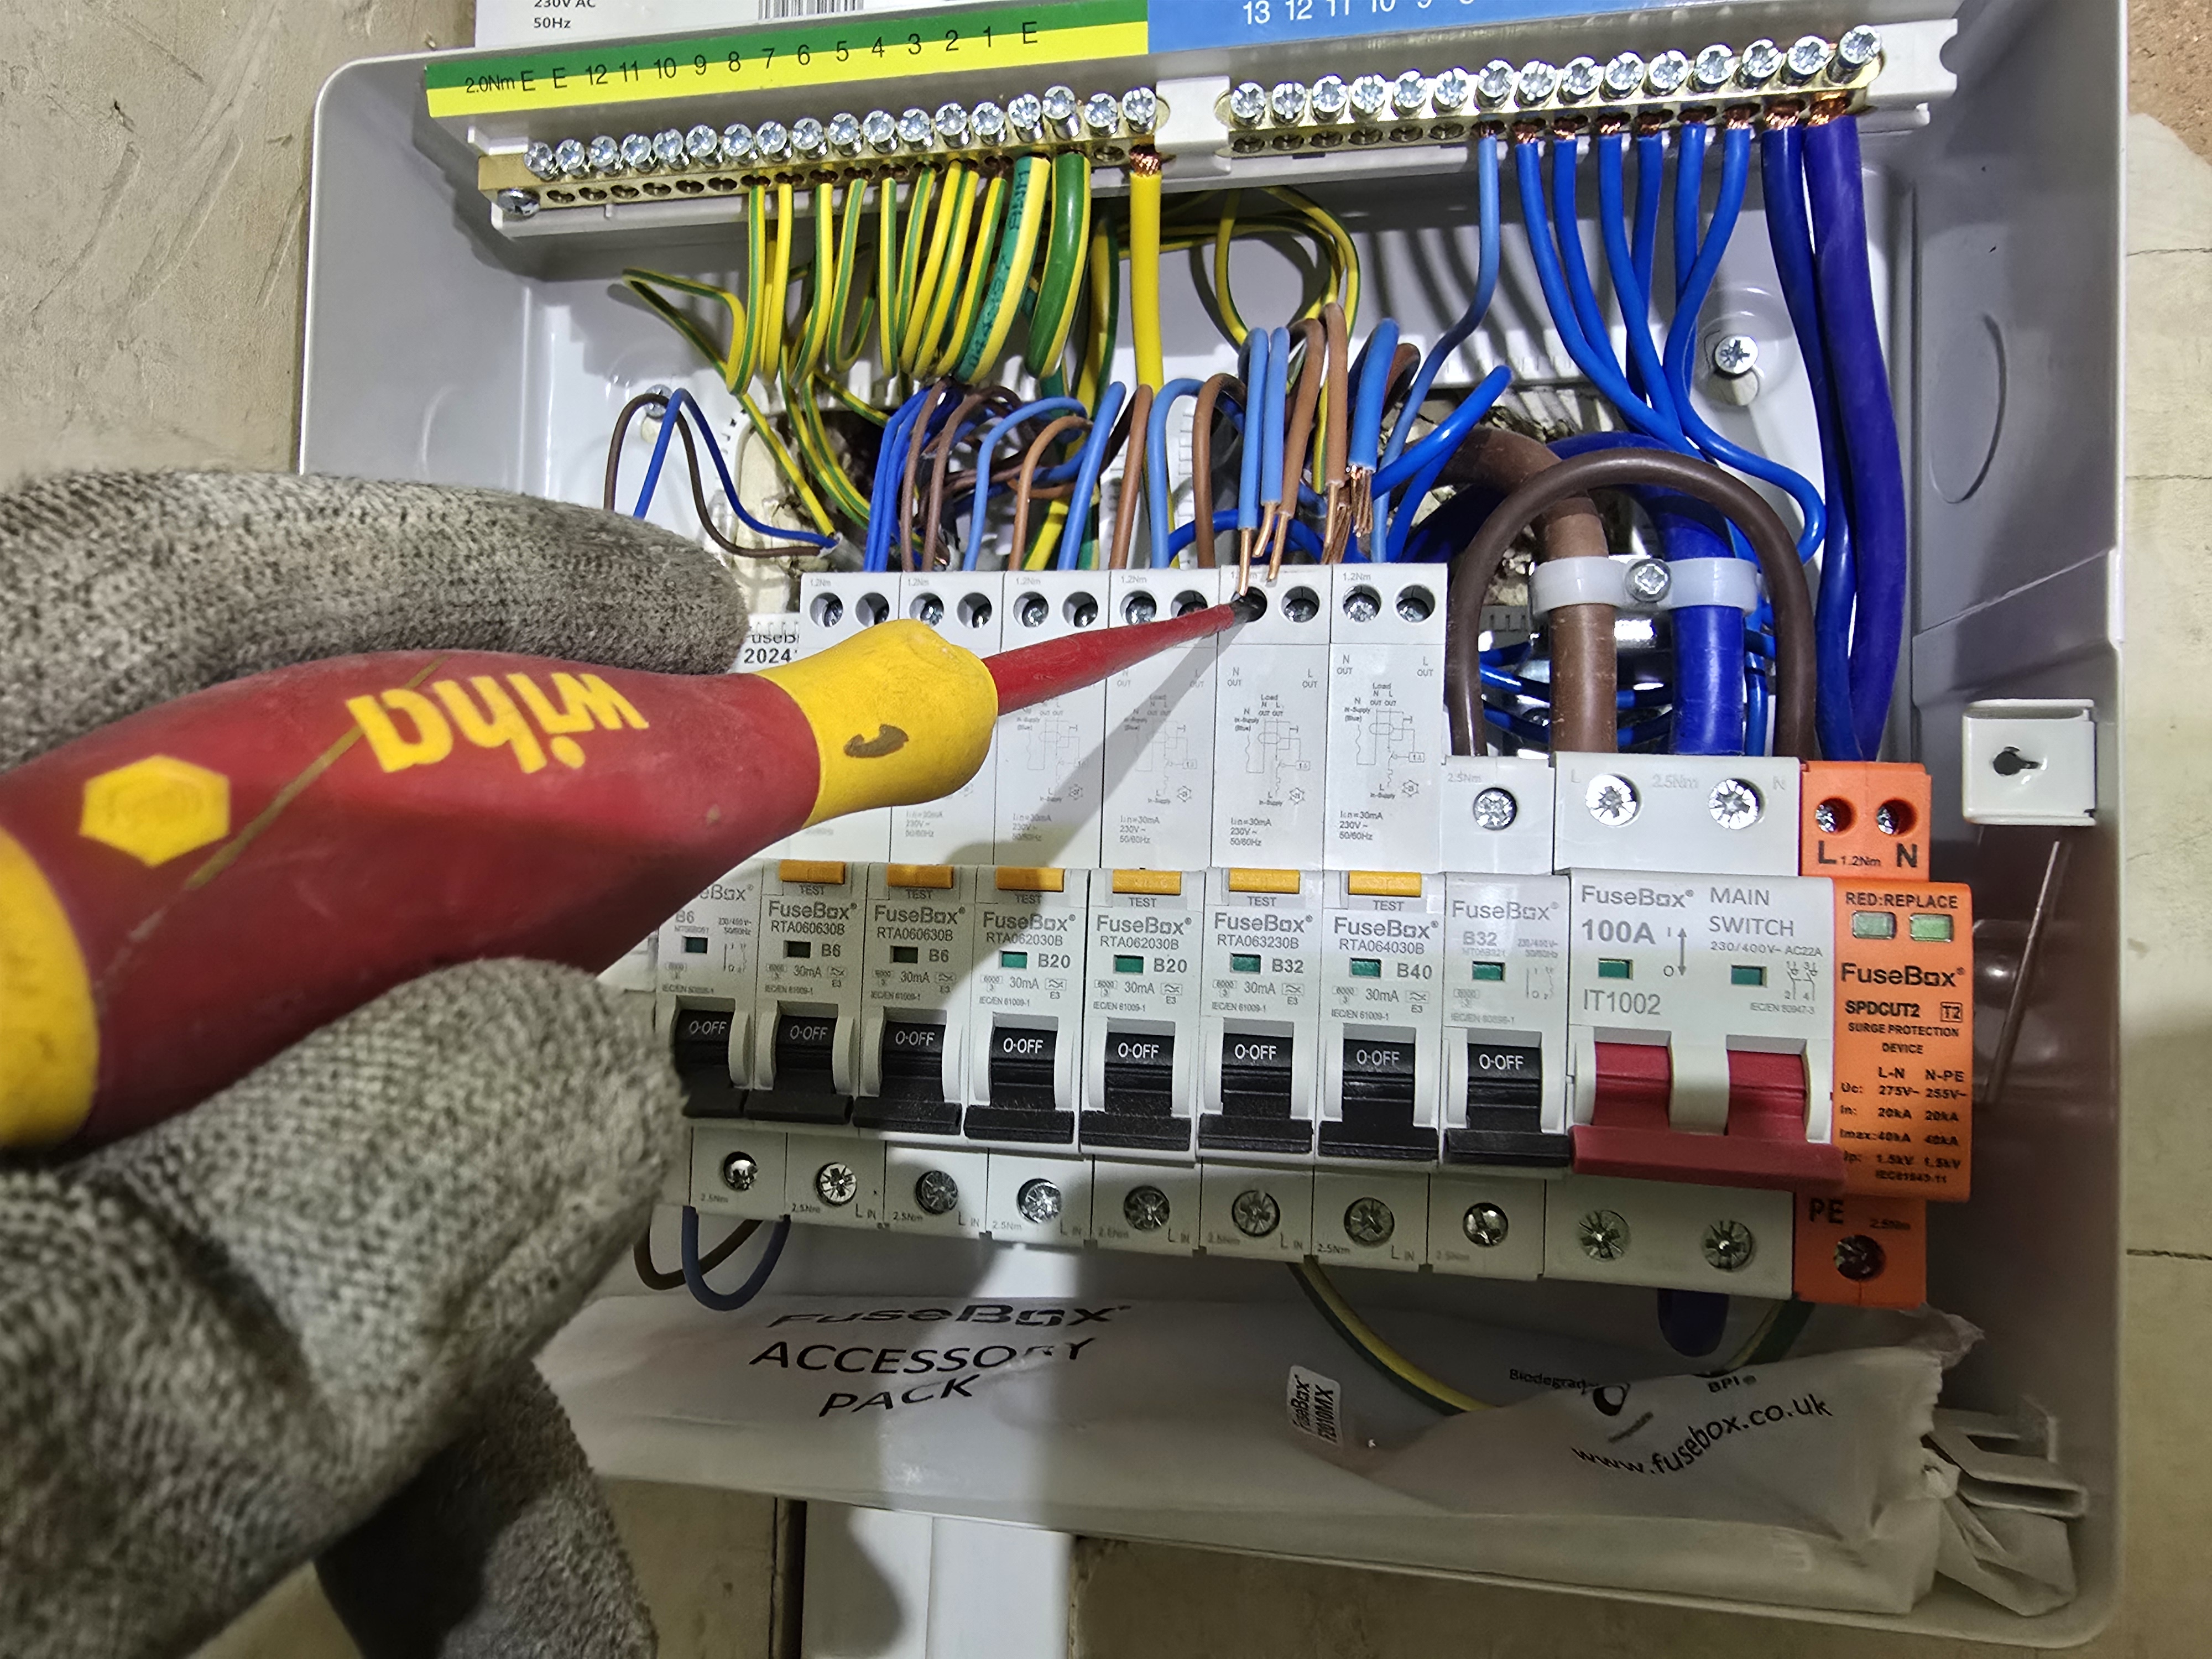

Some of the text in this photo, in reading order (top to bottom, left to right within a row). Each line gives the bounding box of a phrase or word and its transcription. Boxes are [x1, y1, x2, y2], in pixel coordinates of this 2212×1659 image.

[1243, 0, 1271, 25] 13
[1286, 0, 1313, 21] 12
[534, 17, 572, 29] 50Hz
[466, 21, 1039, 94] 2.0Nm E E 12 11 10 9 8 7 6 5 4 3 2 1 E
[1120, 575, 1147, 585] 1.2Nm
[1343, 572, 1371, 582] 1.2Nm
[1343, 654, 1350, 664] N
[1336, 666, 1353, 675] OUT
[1416, 668, 1434, 677] OUT
[1227, 679, 1242, 687] OUT
[1302, 681, 1318, 689] OUT
[1818, 839, 1837, 864] L
[1896, 842, 1918, 868] N
[800, 884, 824, 896] TEST
[905, 888, 933, 900] TEST
[1710, 886, 1770, 906] MAIN
[1014, 894, 1043, 905] TEST
[1129, 896, 1157, 908] TEST
[1247, 895, 1277, 907] TEST
[1373, 899, 1406, 912] TEST
[1845, 891, 1959, 909] RED:REPLACE
[1582, 919, 1656, 945] 100A
[1709, 915, 1794, 937] SWITCH
[986, 931, 1063, 947] RTA062030B
[1100, 935, 1180, 951] RTA062030B
[1217, 933, 1300, 950] RTA063230B
[1339, 937, 1425, 955] RTA064030B
[1462, 930, 1498, 947] B32
[929, 948, 950, 963] B6
[1785, 945, 1824, 957] AC22A
[1038, 952, 1071, 969] B20
[1154, 957, 1188, 974] B20
[1272, 958, 1305, 974] B32
[793, 965, 822, 978] 30mA
[900, 971, 931, 984] 30mA
[1396, 962, 1433, 980] B40
[1009, 975, 1040, 990] 30mA
[1124, 980, 1155, 995] 30mA
[1244, 980, 1276, 995] 30mA
[1365, 988, 1400, 1003] 30mA
[1583, 989, 1661, 1015] IT1002
[1844, 999, 1961, 1020] SPDCUT2 T2
[1848, 1021, 1960, 1038] SURGE PROTECTION
[1881, 1042, 1924, 1055] DEVICE
[1878, 1066, 1965, 1083] L-N N-PE
[1809, 1197, 1845, 1224] PE
[818, 1373, 980, 1417] PACK
[1571, 1392, 1833, 1475] www.fusebox.co.uk
